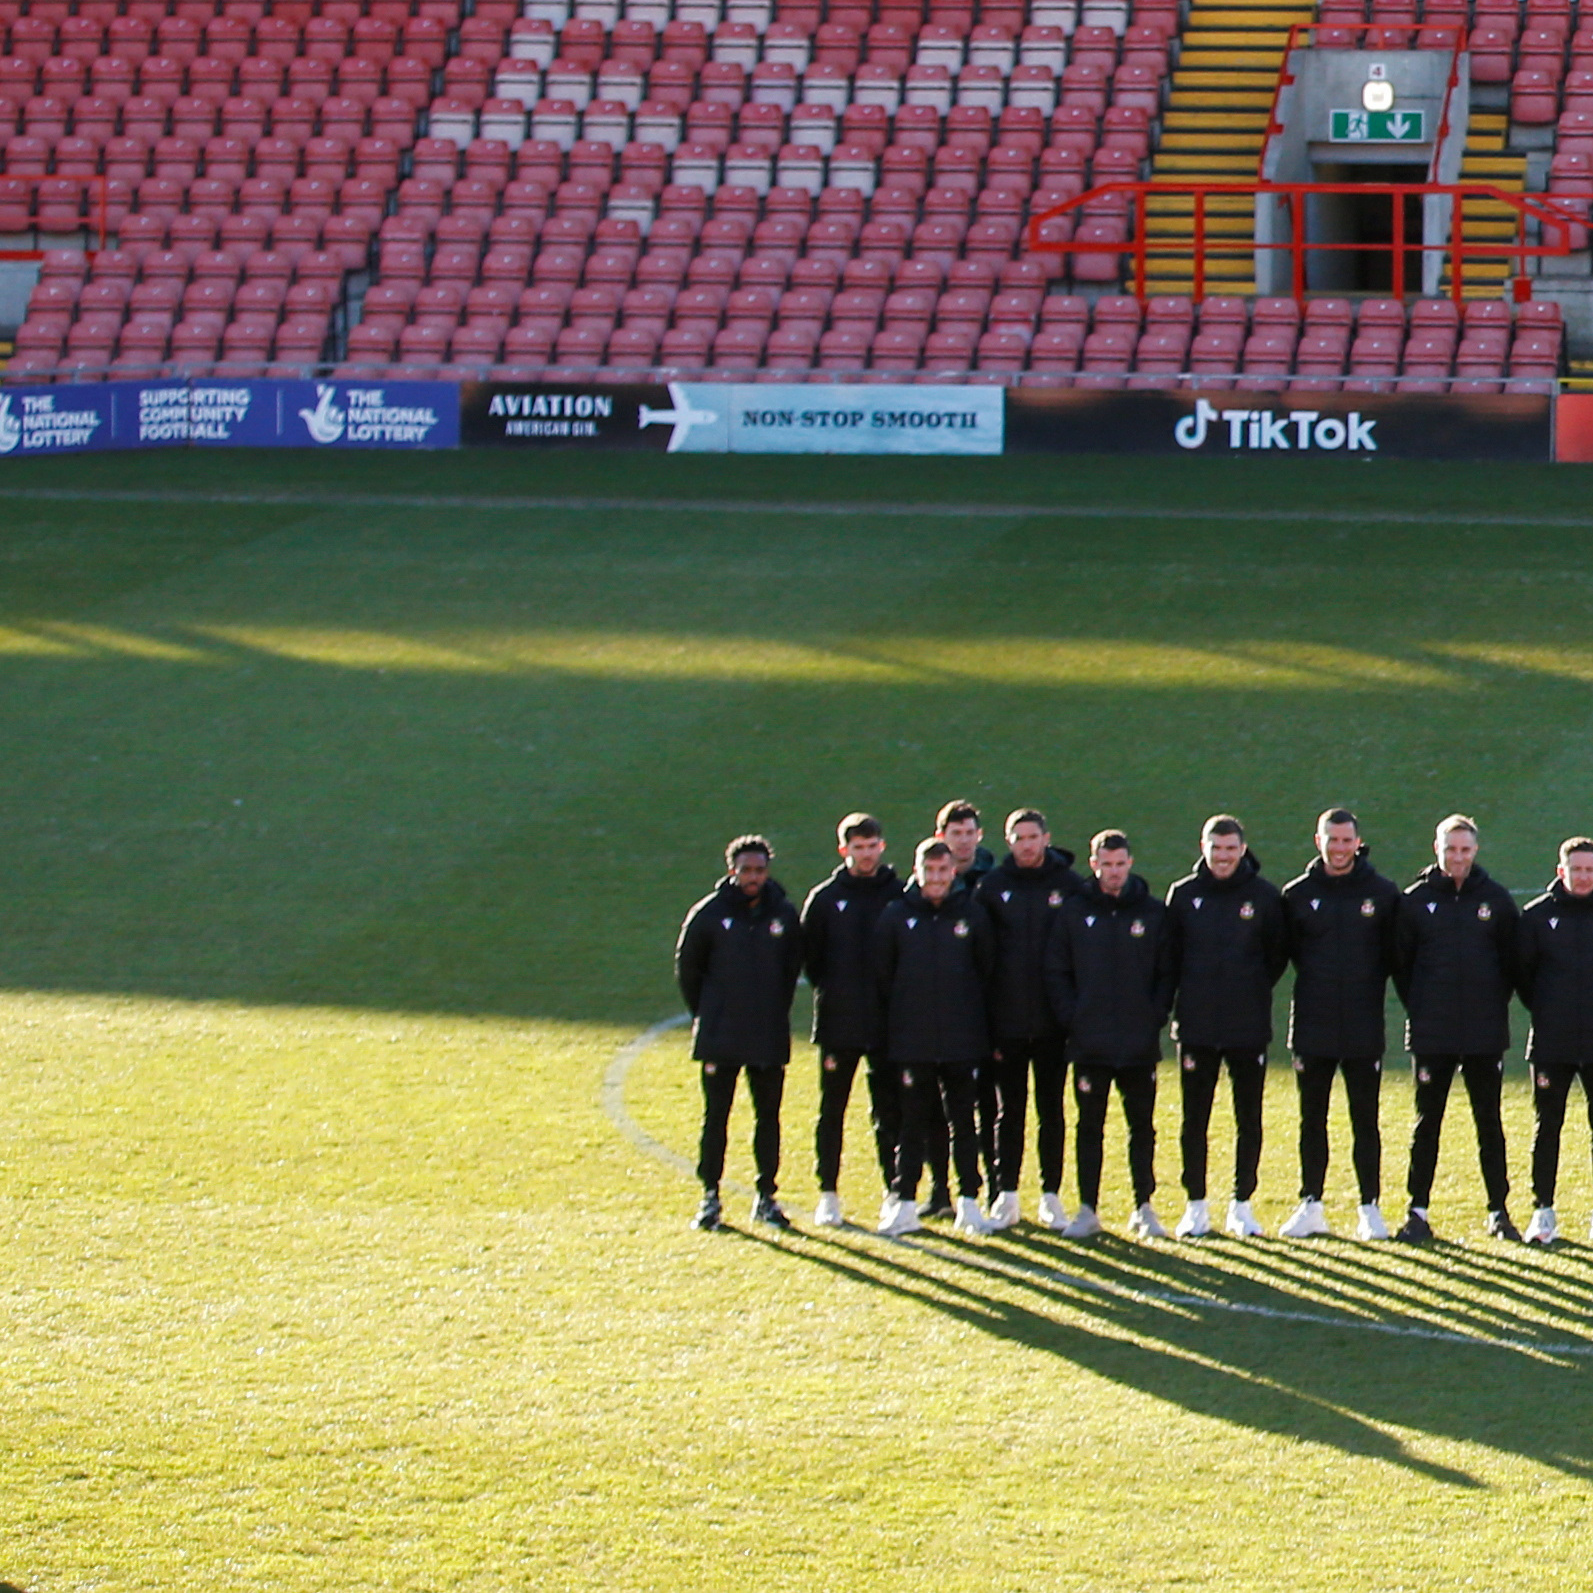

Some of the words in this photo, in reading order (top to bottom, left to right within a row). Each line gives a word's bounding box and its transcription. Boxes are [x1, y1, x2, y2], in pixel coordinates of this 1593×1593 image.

[1372, 66, 1382, 78] 4
[22, 395, 54, 413] THE
[347, 389, 384, 407] THE
[488, 395, 613, 418] AVIATION
[23, 410, 100, 431] NATIONAL
[347, 407, 438, 425] NATIONAL
[872, 410, 980, 428] SMOOTH
[23, 428, 93, 448] LOTTERY
[347, 425, 430, 442] LOTTERY
[505, 421, 570, 437] AMERICAN
[1222, 409, 1378, 450] TikTok
